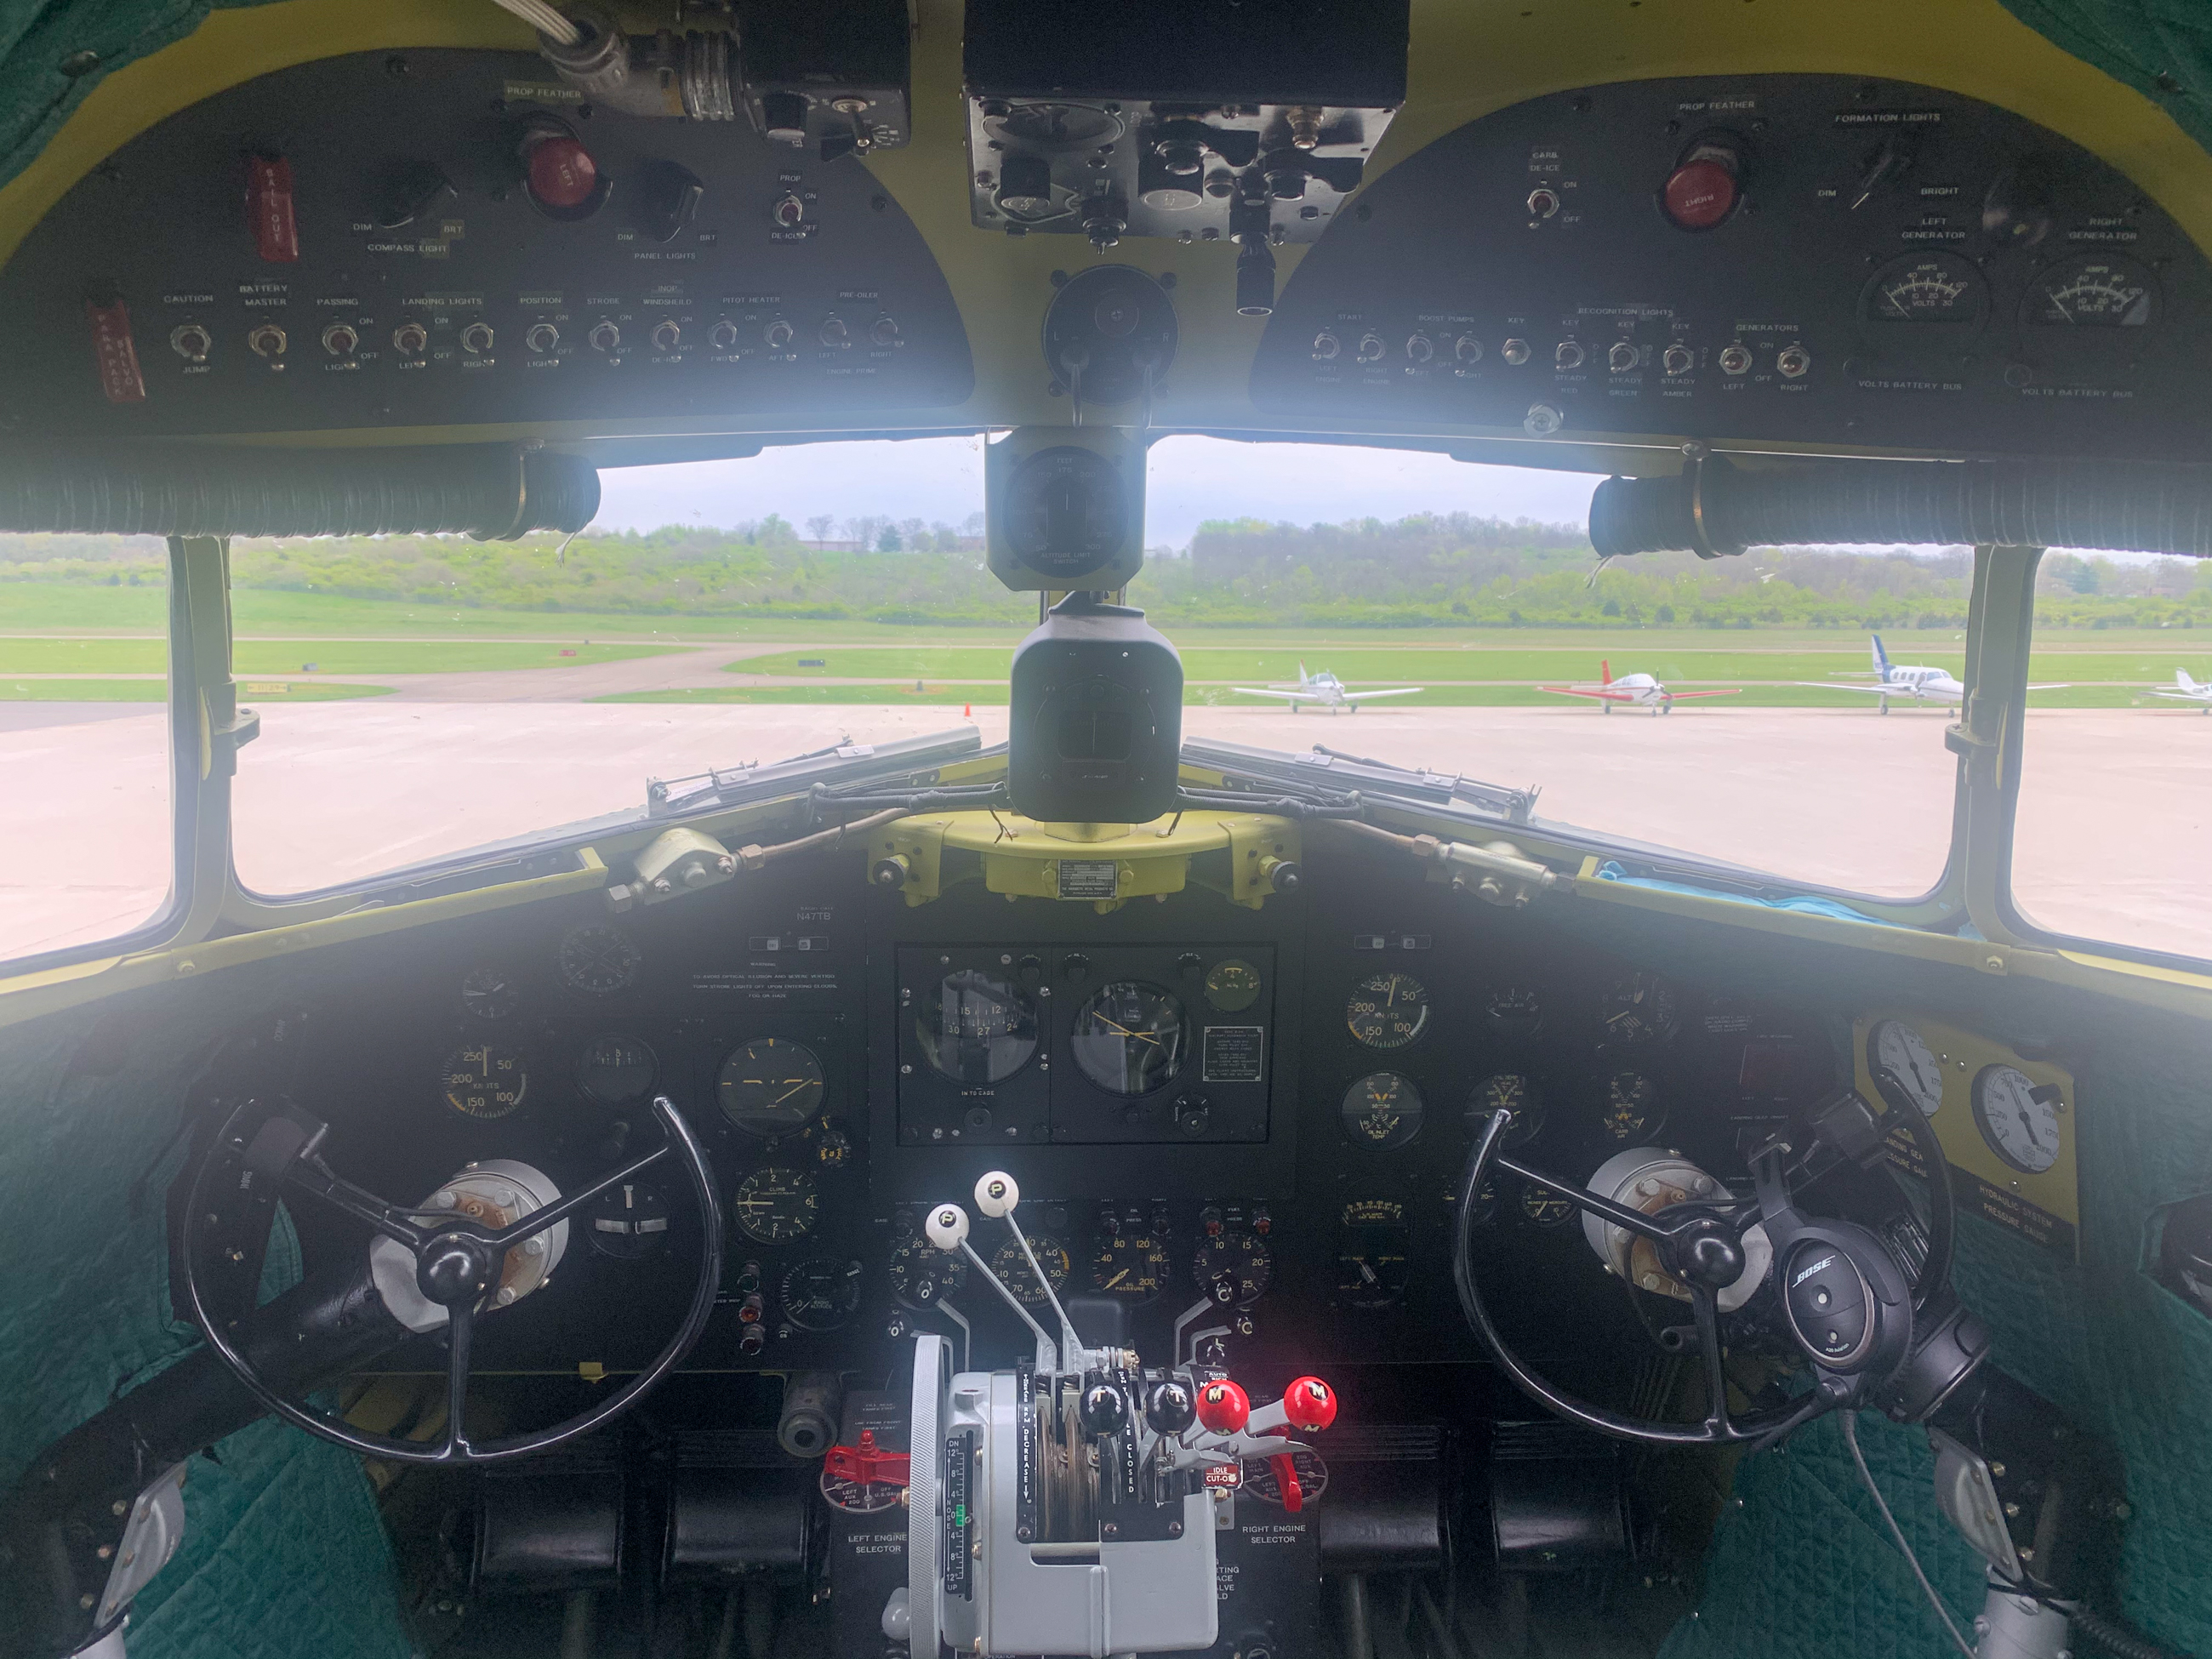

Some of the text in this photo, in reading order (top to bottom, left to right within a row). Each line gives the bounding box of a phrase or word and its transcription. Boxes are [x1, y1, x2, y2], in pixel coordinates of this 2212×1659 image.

[507, 87, 581, 98] PROP FEATHER
[1709, 101, 1754, 110] FEATHER
[1835, 113, 1940, 123] FORMATION LIGHTS
[1921, 187, 1958, 196] BRIGHT
[271, 214, 280, 242] OUT
[1901, 231, 1965, 239] GENERATOR
[2069, 231, 2137, 240] GENERATOR
[368, 243, 447, 253] COMPASS LIGHT
[98, 315, 122, 395] PARA PACK
[117, 339, 133, 385] SALVO
[1859, 380, 1890, 389] VOLTS
[1892, 381, 1937, 390] BATTERY
[2022, 388, 2055, 396] VOLTS
[2059, 390, 2107, 398] BATTERY
[1371, 982, 1390, 991] 250
[1402, 992, 1416, 1001] 50
[1354, 1003, 1375, 1012] 200
[978, 1027, 990, 1035] 27
[1365, 1027, 1382, 1036] 150
[1394, 1023, 1411, 1032] 100
[463, 1052, 482, 1061] 250
[497, 1060, 511, 1069] 50
[452, 1074, 472, 1083] 200
[2015, 1075, 2029, 1086] 1000
[467, 1097, 484, 1106] 150
[496, 1092, 513, 1102] 100
[1993, 1091, 2004, 1102] 500
[991, 1183, 1003, 1195] P
[1979, 1185, 2052, 1229] HYDRAULIC SYSTEM
[941, 1213, 954, 1224] P
[1984, 1202, 2048, 1243] PRESSURE GAUGE
[1793, 1255, 1835, 1288] BOSE
[1218, 1289, 1231, 1302] C
[1241, 1322, 1252, 1335] C
[1093, 1390, 1106, 1402] T
[1208, 1388, 1223, 1401] M
[1312, 1384, 1325, 1398] M
[1168, 1390, 1180, 1403] T
[856, 1545, 901, 1554] SELECTOR
